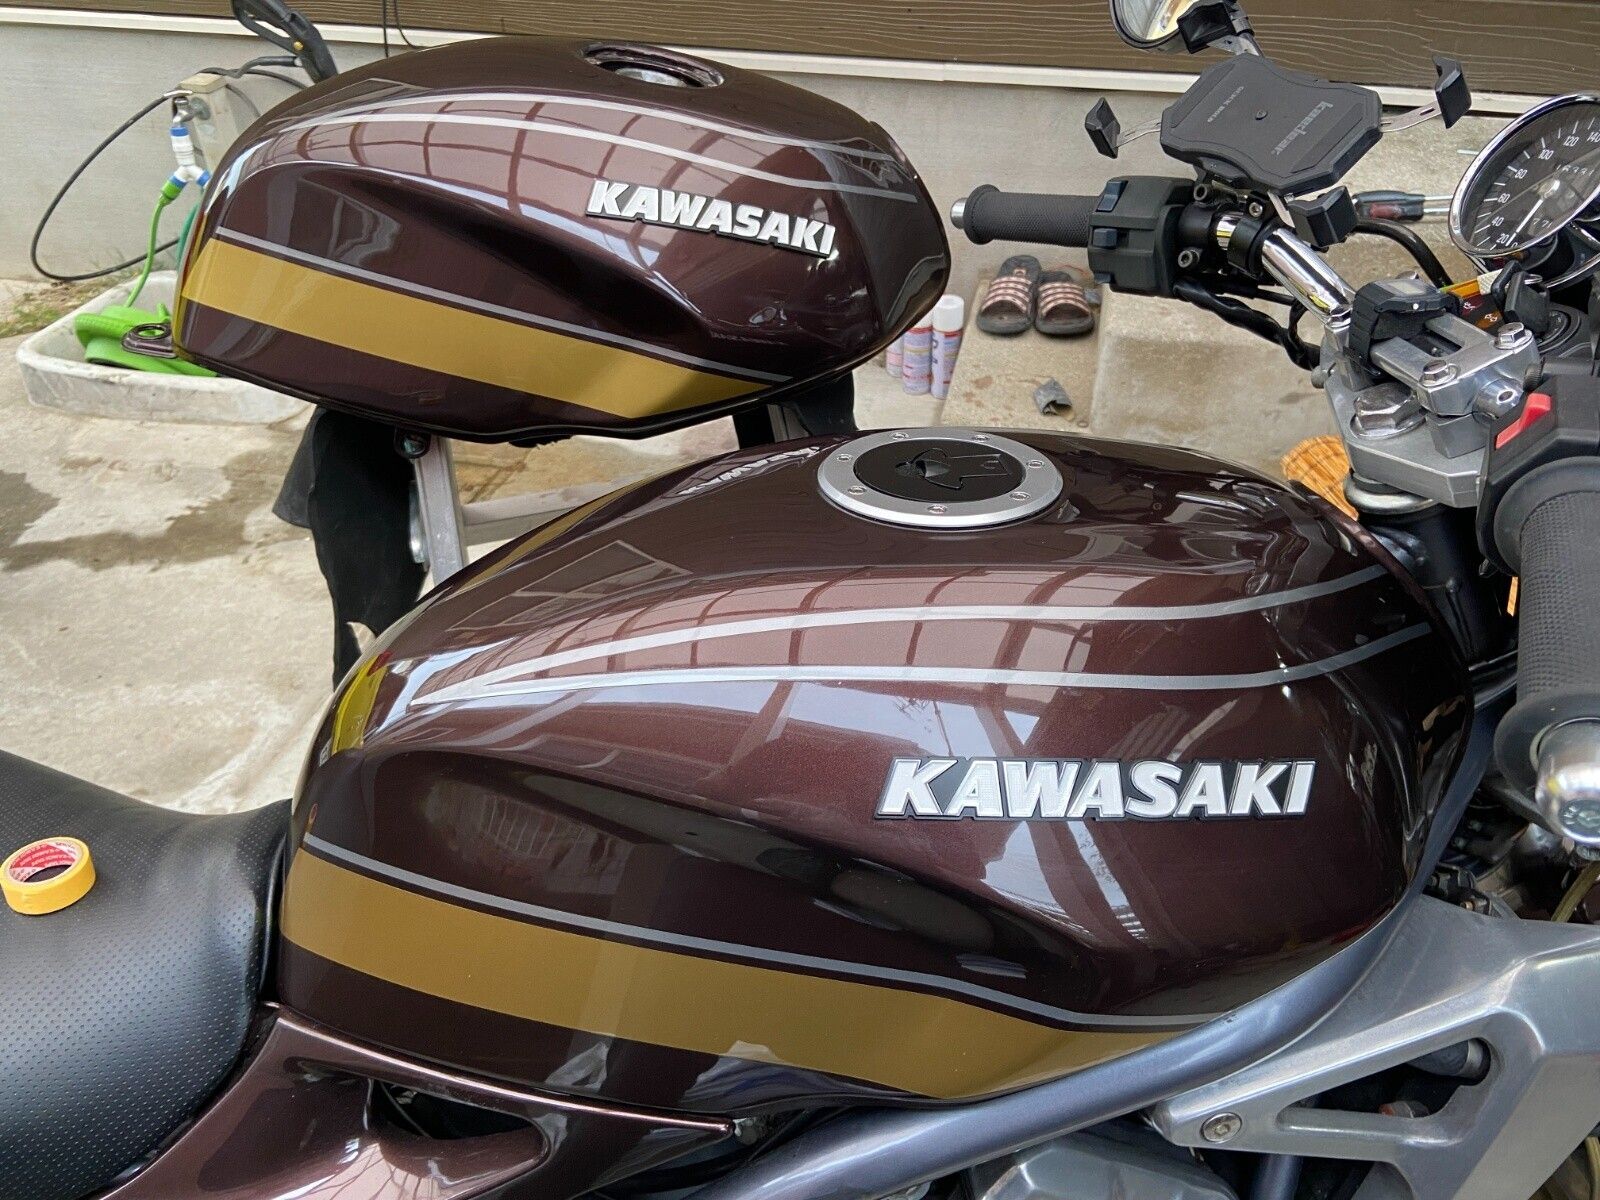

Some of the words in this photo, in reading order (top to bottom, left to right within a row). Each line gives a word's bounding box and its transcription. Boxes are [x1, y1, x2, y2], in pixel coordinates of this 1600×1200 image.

[1563, 135, 1580, 147] 120
[1538, 149, 1554, 160] 100
[1514, 168, 1528, 179] 80
[1498, 193, 1511, 204] 60
[586, 179, 836, 256] KAWASAKI
[1491, 216, 1505, 227] 40
[1496, 233, 1510, 244] 20
[877, 758, 1316, 818] KAWASAKI
